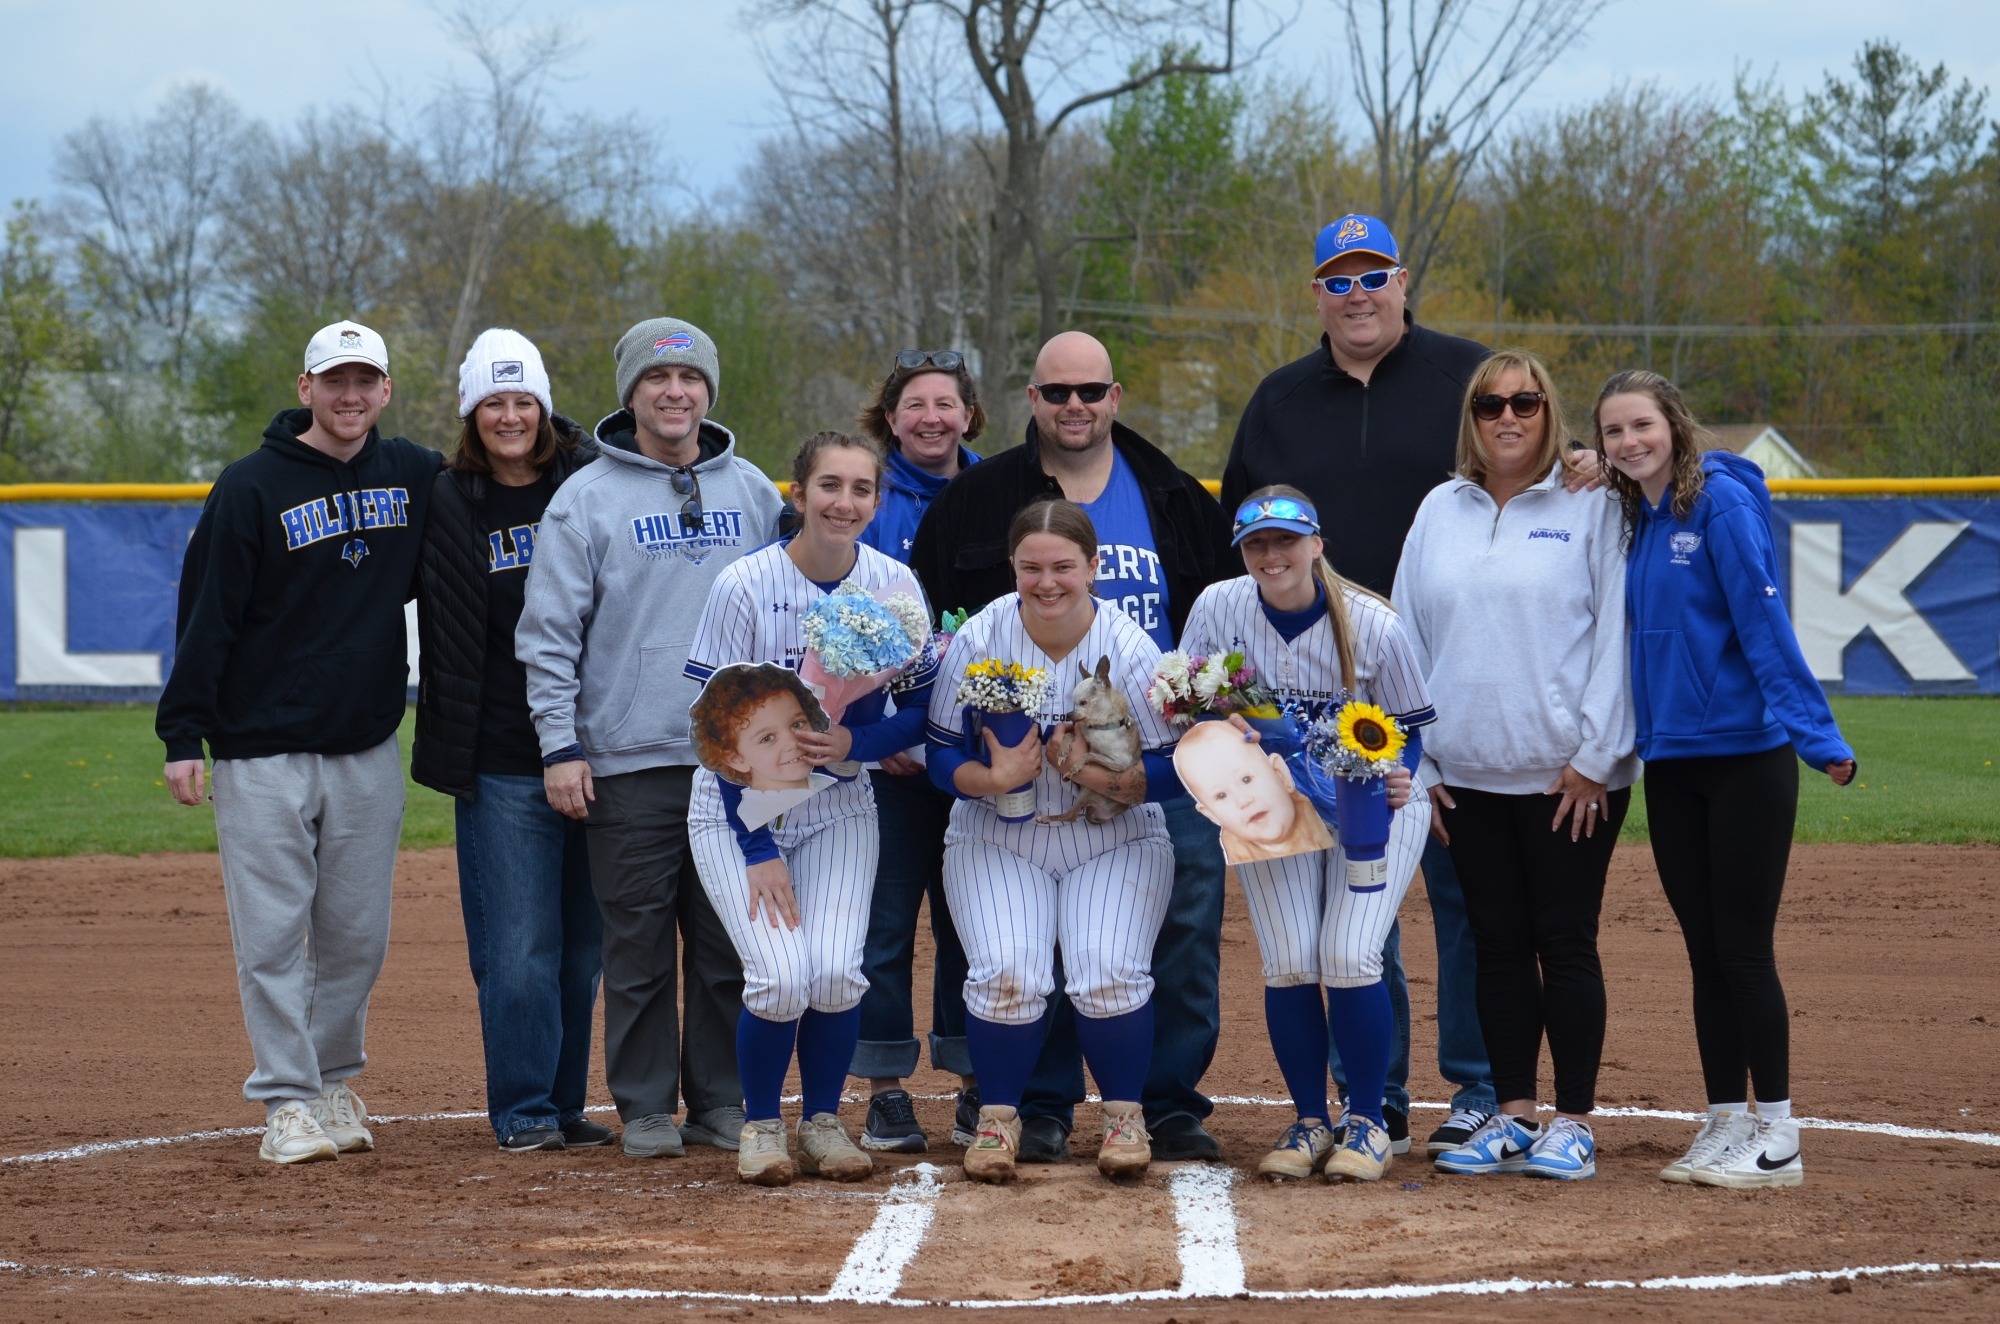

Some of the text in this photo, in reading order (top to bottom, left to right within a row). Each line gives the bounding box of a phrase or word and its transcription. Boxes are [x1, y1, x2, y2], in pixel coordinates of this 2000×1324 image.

[280, 487, 410, 551] HILBERT
[1528, 531, 1571, 542] HAWKS
[489, 522, 541, 573] LB
[646, 538, 741, 552] SOFTBALL
[14, 527, 162, 686] L
[1103, 593, 1160, 630] GE
[1791, 521, 1978, 680] K
[1290, 688, 1333, 699] COLLEGE
